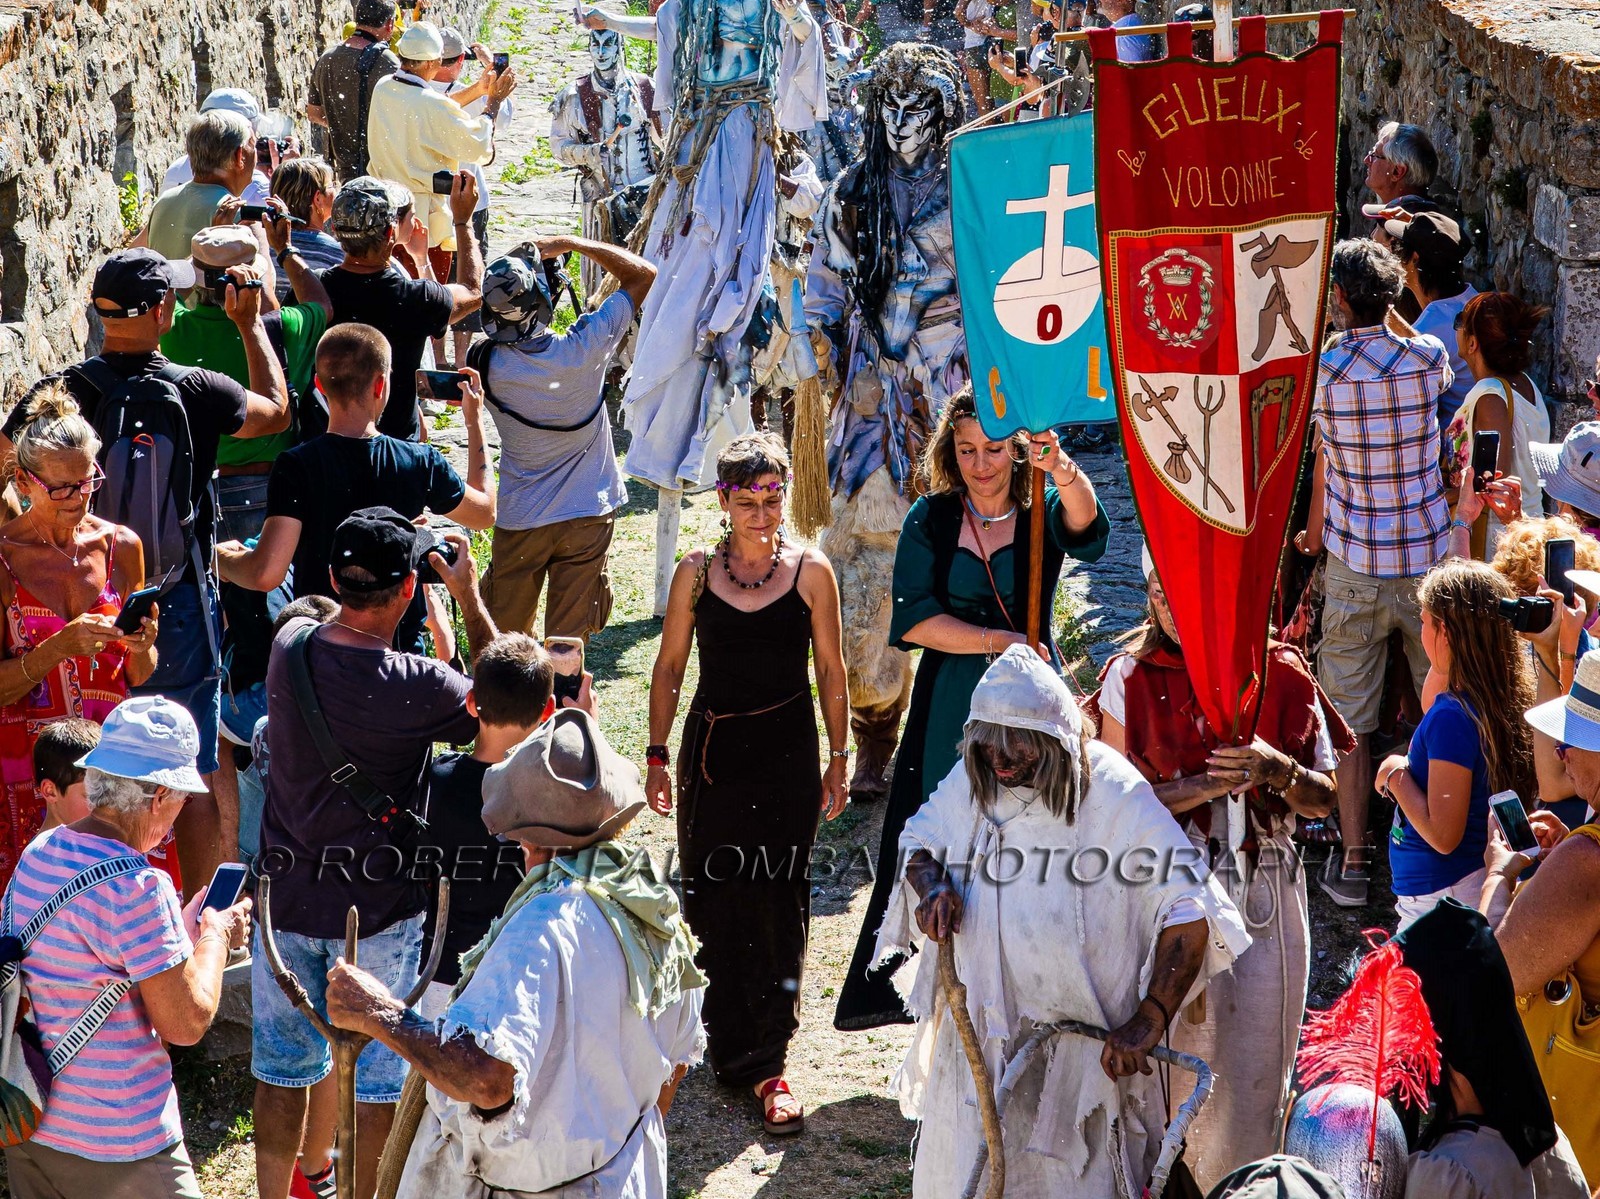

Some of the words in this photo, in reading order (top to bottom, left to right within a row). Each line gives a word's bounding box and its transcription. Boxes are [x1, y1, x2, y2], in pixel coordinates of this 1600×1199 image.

[1142, 75, 1301, 139] GUEUX
[1293, 130, 1318, 160] de
[1162, 156, 1285, 207] VOLONNE
